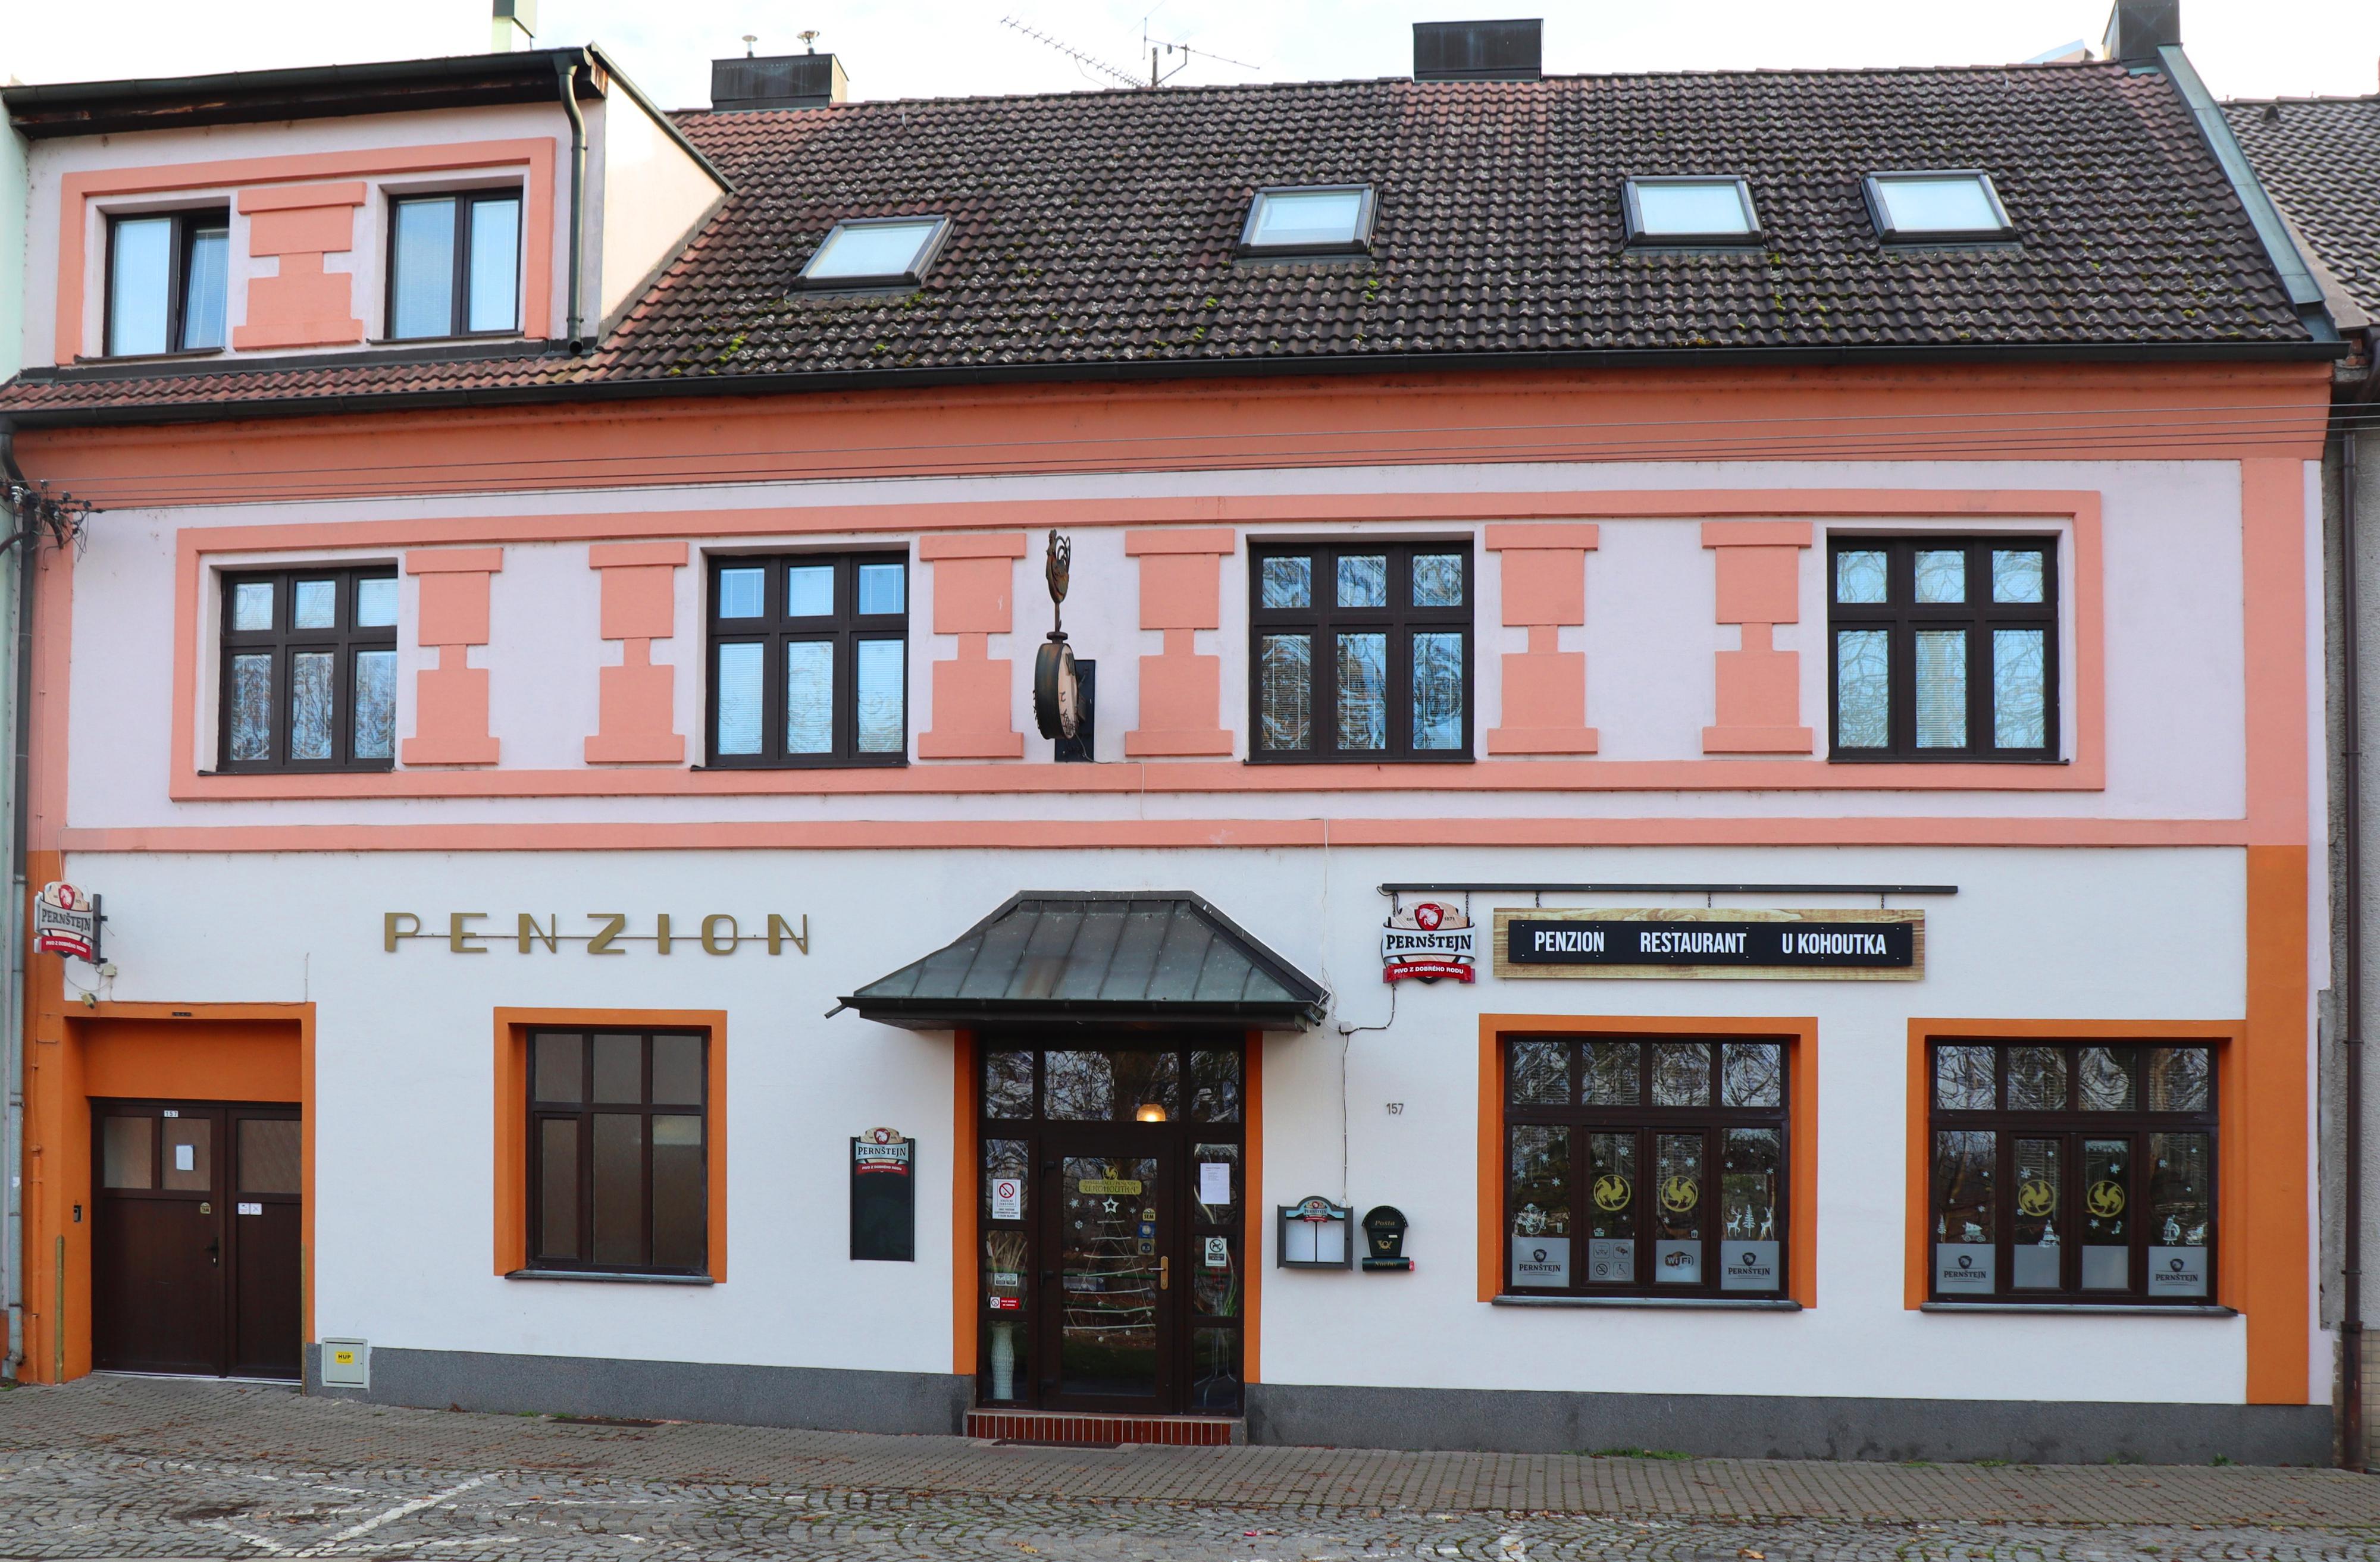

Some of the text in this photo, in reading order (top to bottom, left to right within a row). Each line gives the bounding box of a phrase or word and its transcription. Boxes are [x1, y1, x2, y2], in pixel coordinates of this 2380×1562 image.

[42, 908, 92, 931] PERNŠTEJN
[384, 912, 807, 955] PENZION
[1386, 933, 1472, 952] PERNŠTEJN
[1535, 931, 1887, 955] PENZION RESTAURANT U KOHOUTKA
[1386, 1103, 1404, 1115] 157
[857, 1146, 906, 1157] PERNŠTEJN
[1519, 1263, 1561, 1272] PERNŠTEJN
[1728, 1266, 1770, 1275] PERNŠTEJN
[1944, 1270, 1986, 1279] PERNŠTEJN
[2156, 1274, 2198, 1282] PERNŠTEJN
